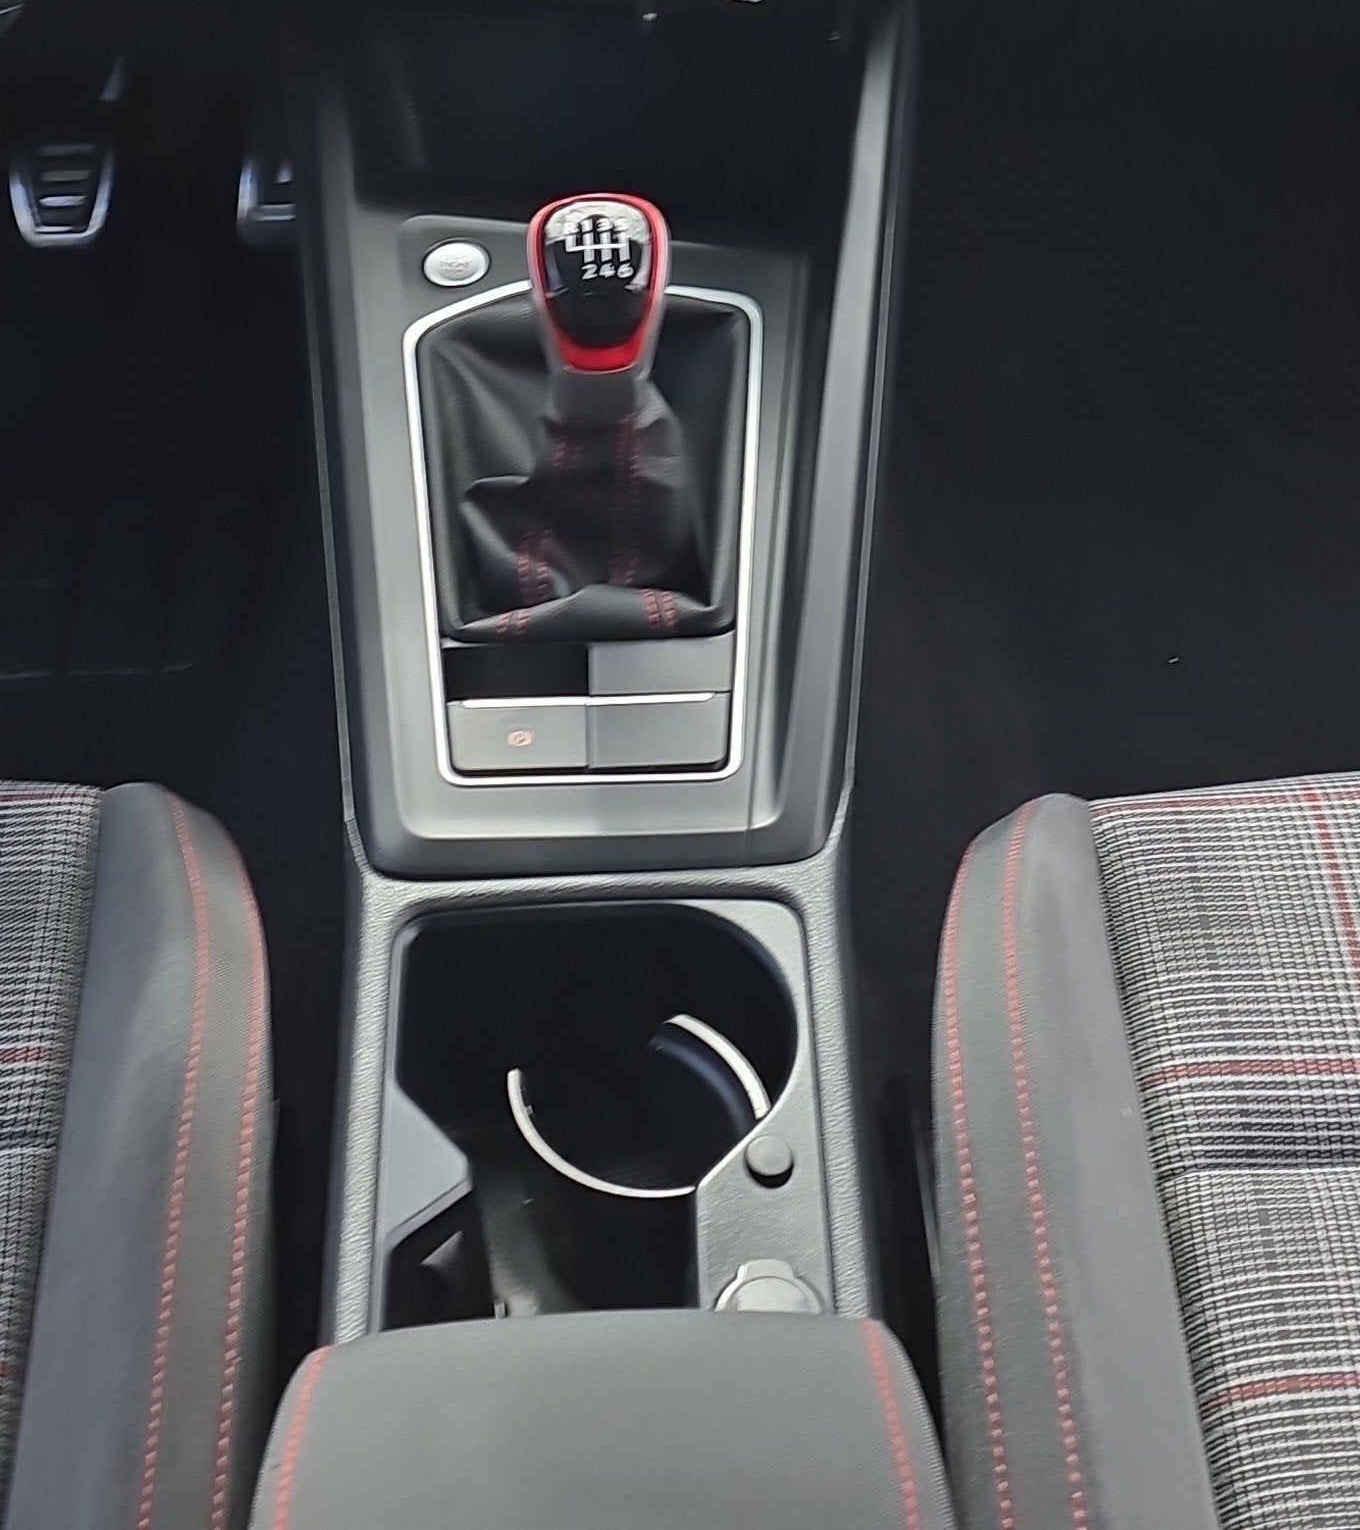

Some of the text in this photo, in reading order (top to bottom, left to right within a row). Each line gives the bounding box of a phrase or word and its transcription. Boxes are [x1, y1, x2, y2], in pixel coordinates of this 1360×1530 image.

[563, 221, 579, 235] R
[581, 219, 593, 232] 1
[596, 218, 613, 232] 3
[581, 263, 634, 280] 2 4 6
